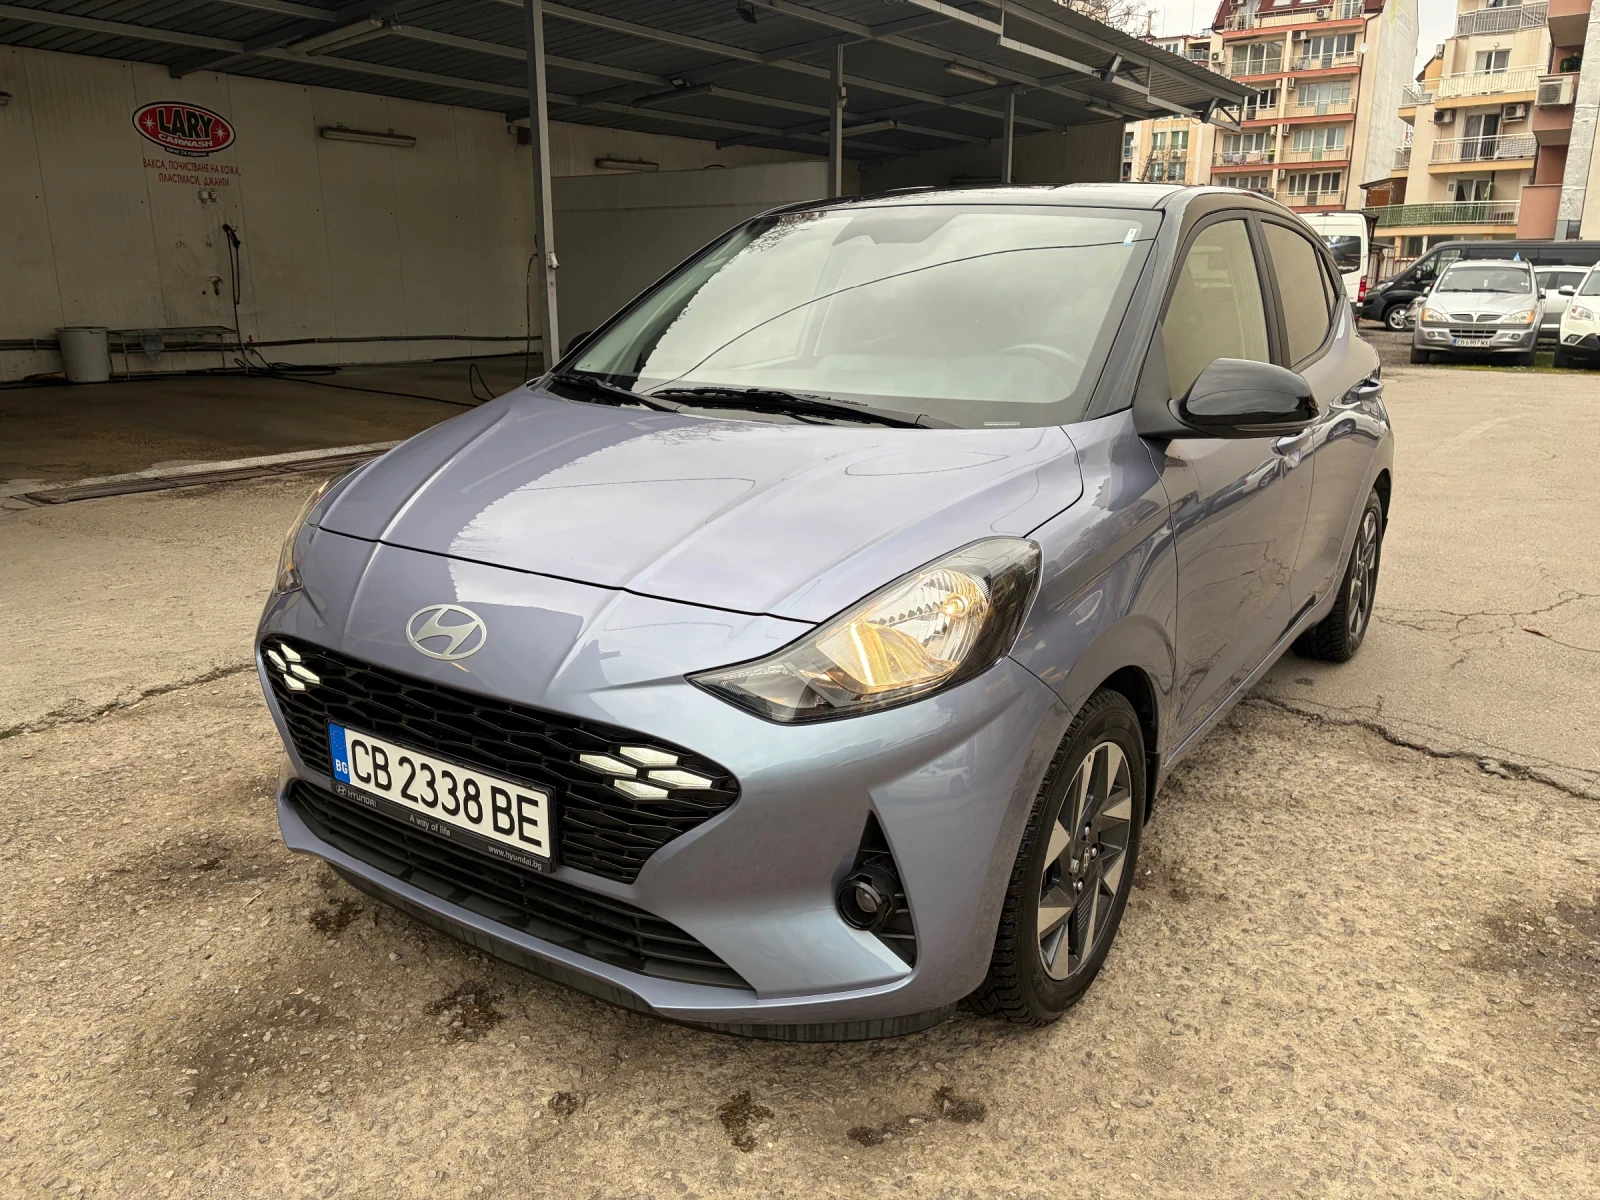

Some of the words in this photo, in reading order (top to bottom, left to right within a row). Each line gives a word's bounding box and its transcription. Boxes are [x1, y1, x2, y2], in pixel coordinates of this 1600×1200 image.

[157, 108, 214, 139] LARY
[158, 133, 213, 148] CARWASH
[143, 158, 168, 170] ВАКСА,
[168, 160, 210, 173] ПОЧИСТВАНЕ
[210, 164, 220, 174] НА
[220, 165, 241, 177] КОЖА,
[159, 172, 200, 186] ПЛАСТМАСИ,
[204, 176, 229, 187] ДЖАНТИ
[335, 758, 348, 775] BG
[347, 789, 378, 808] HYUNDAI
[350, 739, 393, 792] CB
[398, 756, 484, 824] 2338
[490, 784, 543, 848] BE
[409, 813, 416, 823] A
[416, 816, 430, 830] way
[430, 822, 440, 833] of
[439, 825, 452, 837] life
[487, 844, 543, 872] www.hyundai.bg
